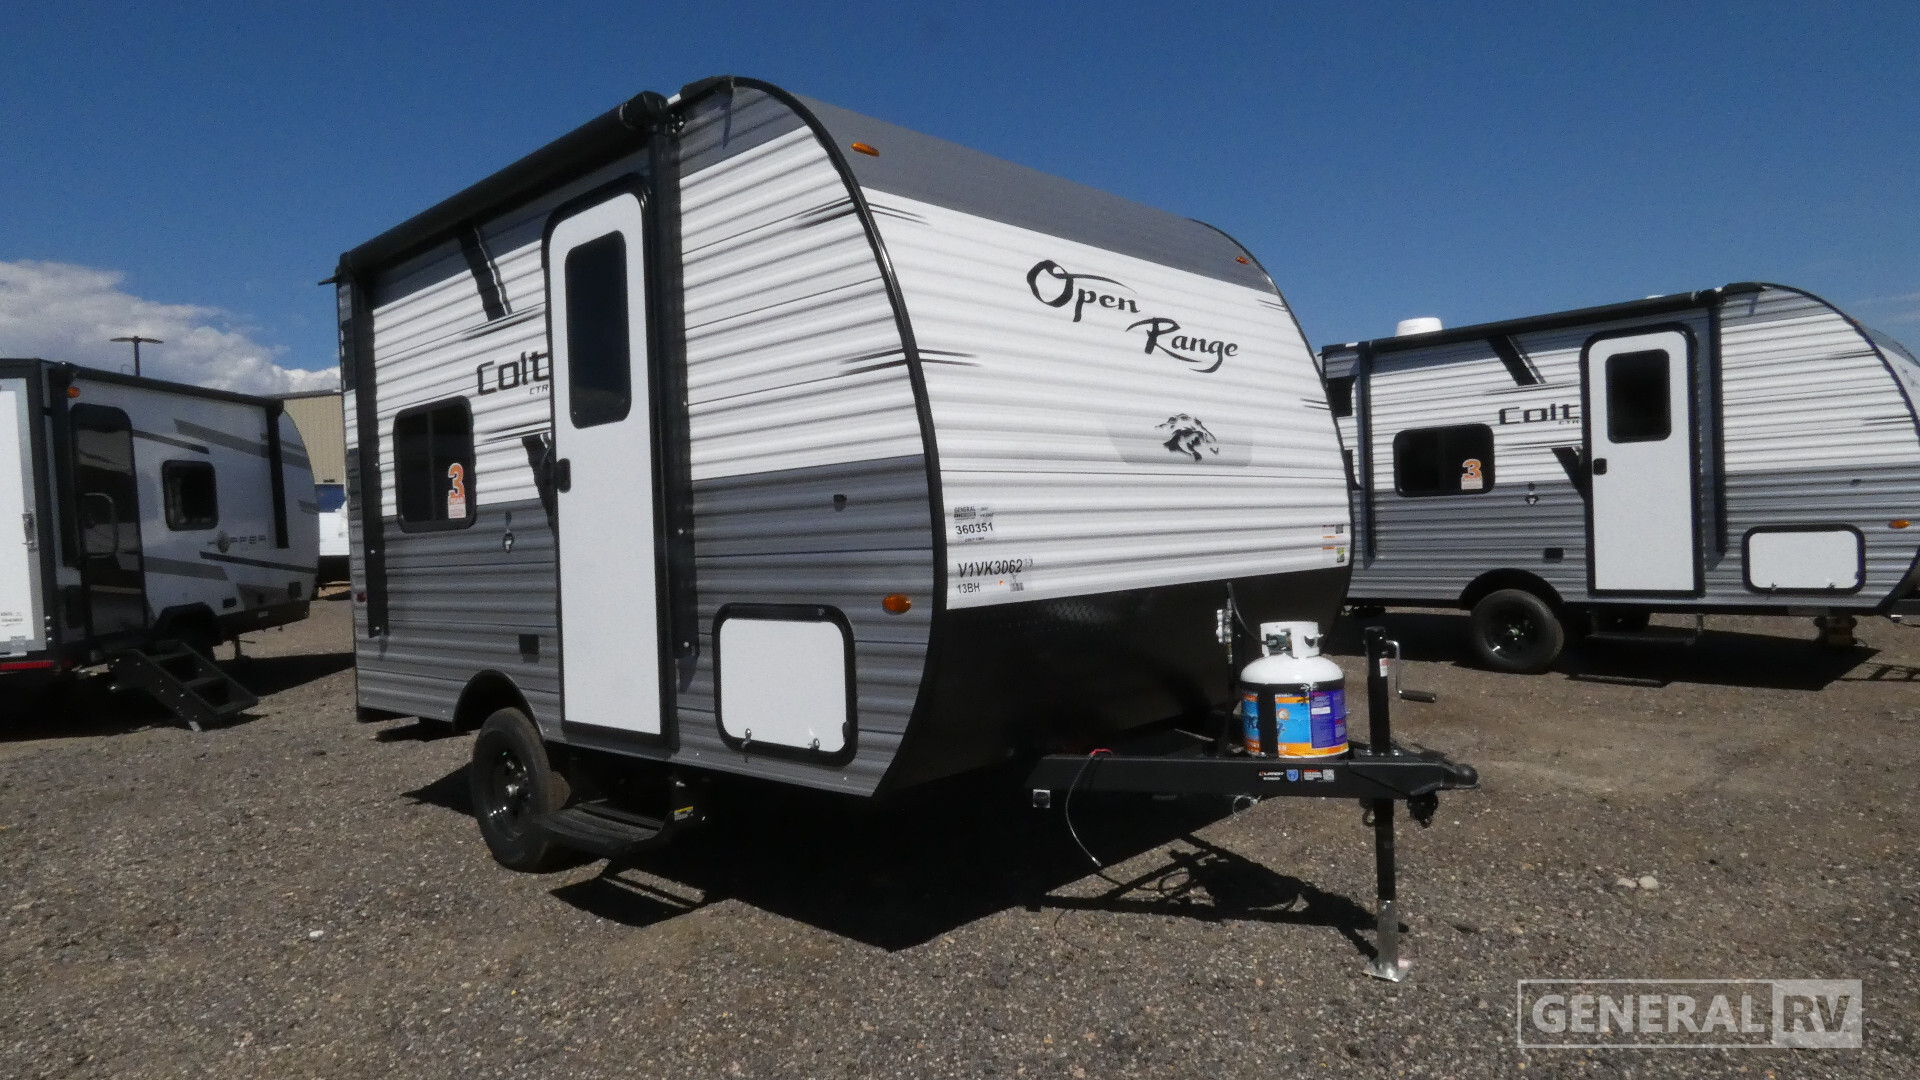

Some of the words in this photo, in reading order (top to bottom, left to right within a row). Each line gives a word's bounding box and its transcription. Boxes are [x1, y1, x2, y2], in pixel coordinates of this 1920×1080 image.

[1026, 259, 1141, 323] Open
[1125, 317, 1239, 374] Range
[477, 350, 549, 396] Colt
[529, 384, 549, 395] CTR
[1499, 403, 1580, 425] Colt
[447, 462, 465, 499] 3
[1461, 459, 1482, 480] 3
[955, 521, 994, 535] 360351
[957, 582, 981, 594] 13BH
